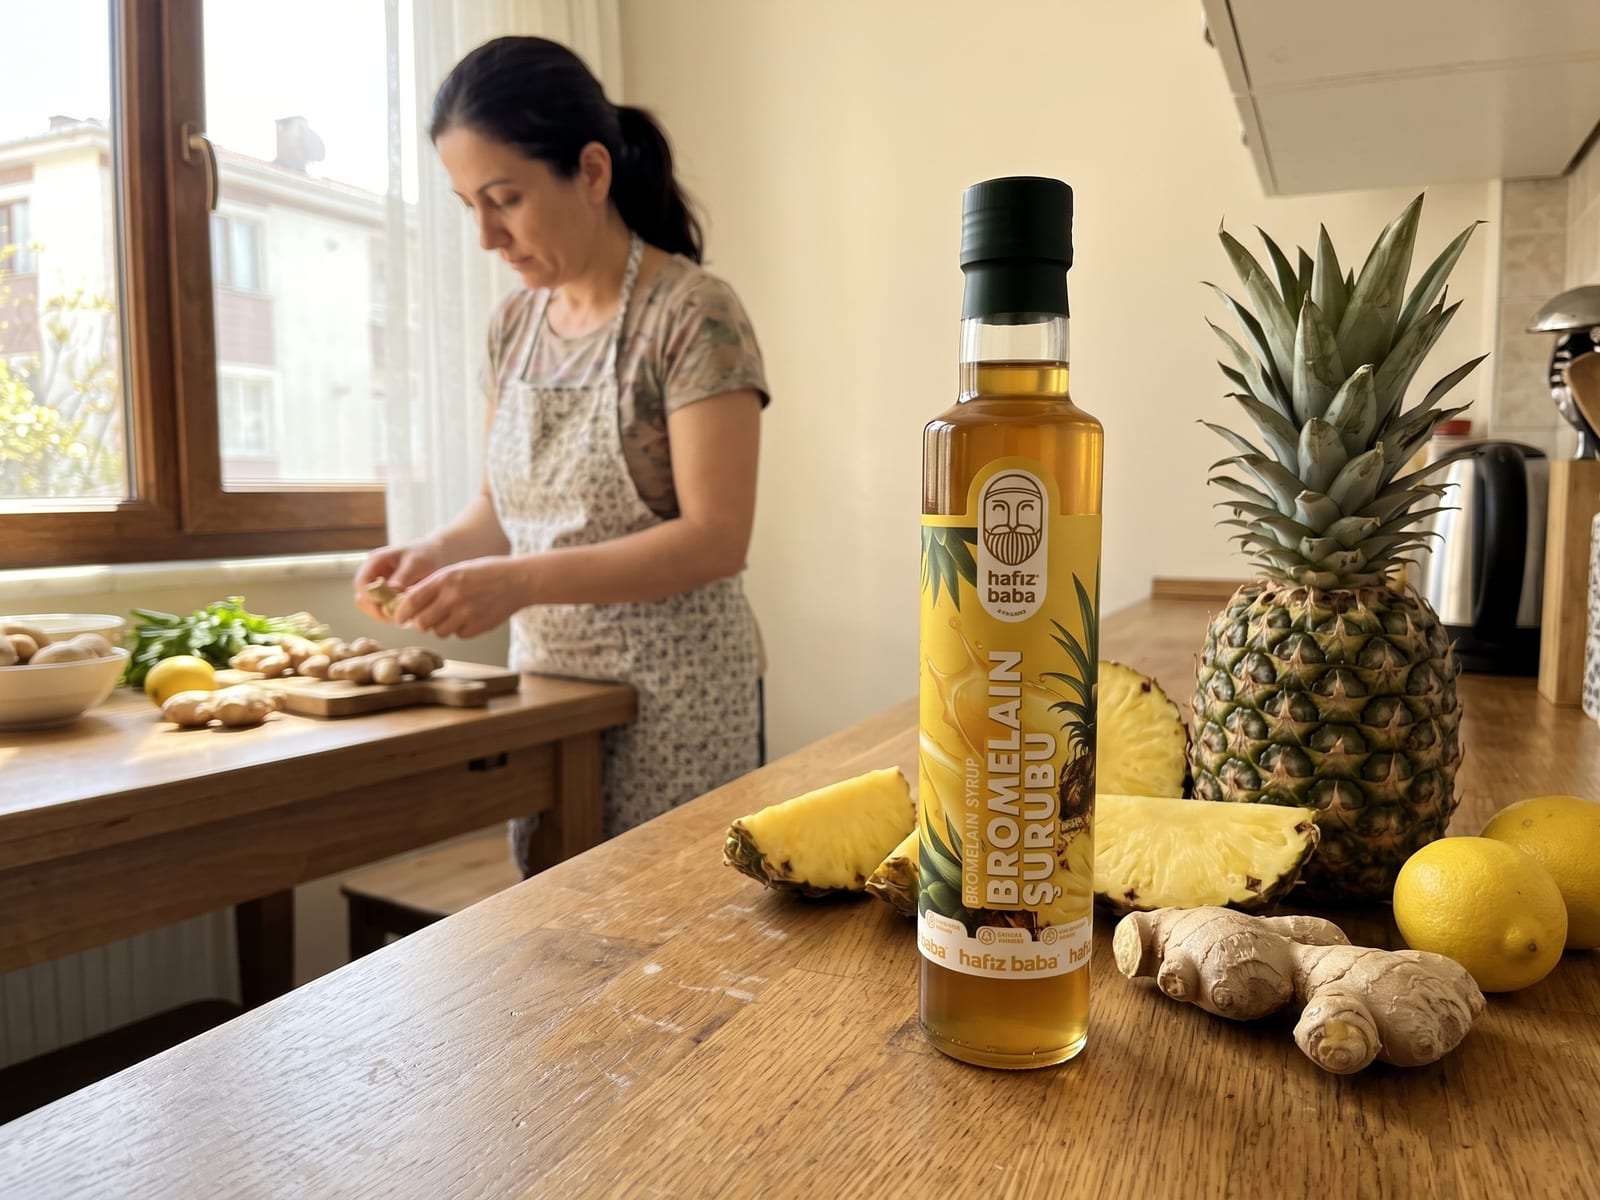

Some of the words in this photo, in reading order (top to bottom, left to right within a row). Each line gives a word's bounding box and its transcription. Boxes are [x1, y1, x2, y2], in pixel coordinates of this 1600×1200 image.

[988, 587, 1036, 604] baba
[965, 758, 980, 808] SYRUP
[986, 651, 1022, 906] BROMELAIN
[1022, 733, 1062, 906] ŞURUBU
[965, 814, 980, 905] BROMELAIN
[1011, 955, 1057, 972] baba
